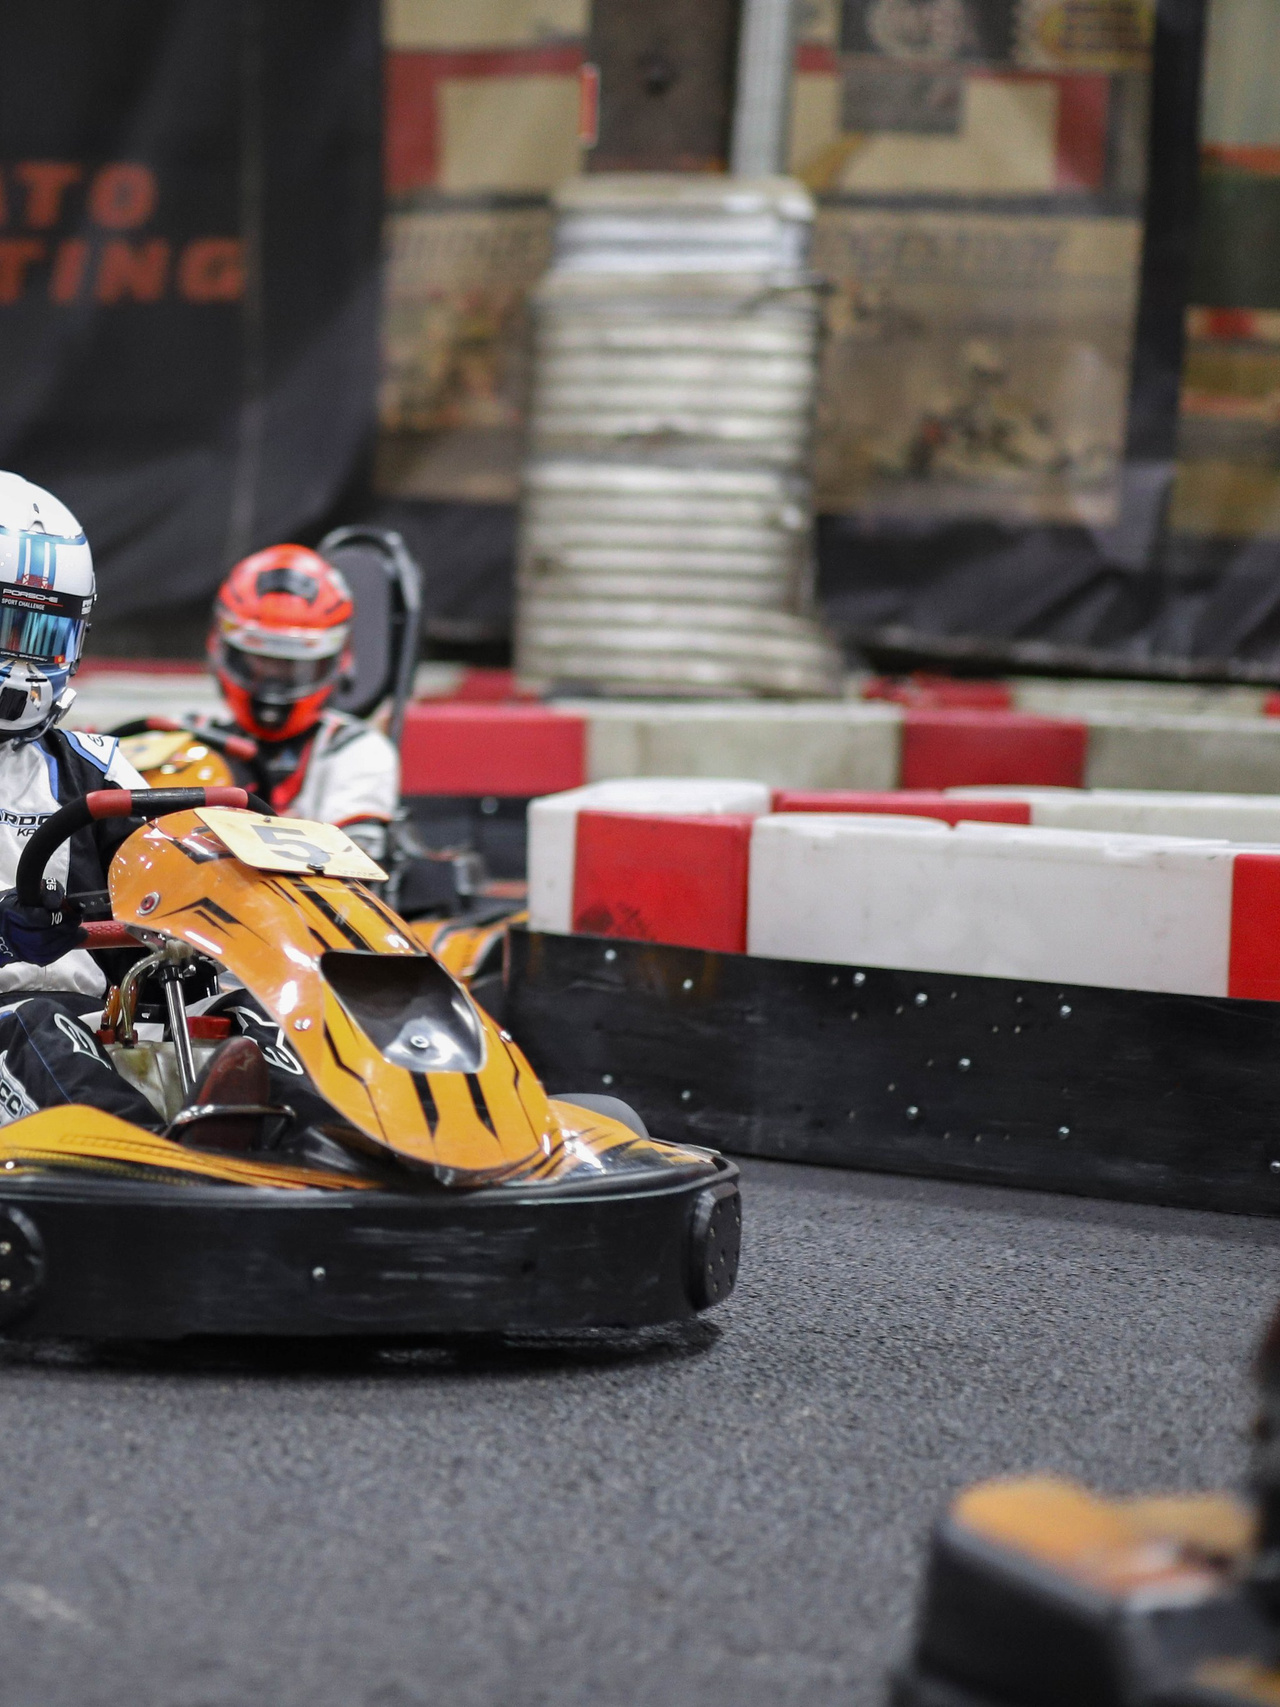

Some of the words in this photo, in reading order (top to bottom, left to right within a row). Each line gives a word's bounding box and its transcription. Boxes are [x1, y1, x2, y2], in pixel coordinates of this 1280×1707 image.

[3, 588, 58, 604] PORSCHE
[1, 598, 17, 606] SPORT
[18, 600, 45, 611] CHALLENGE
[251, 824, 331, 865] 5
